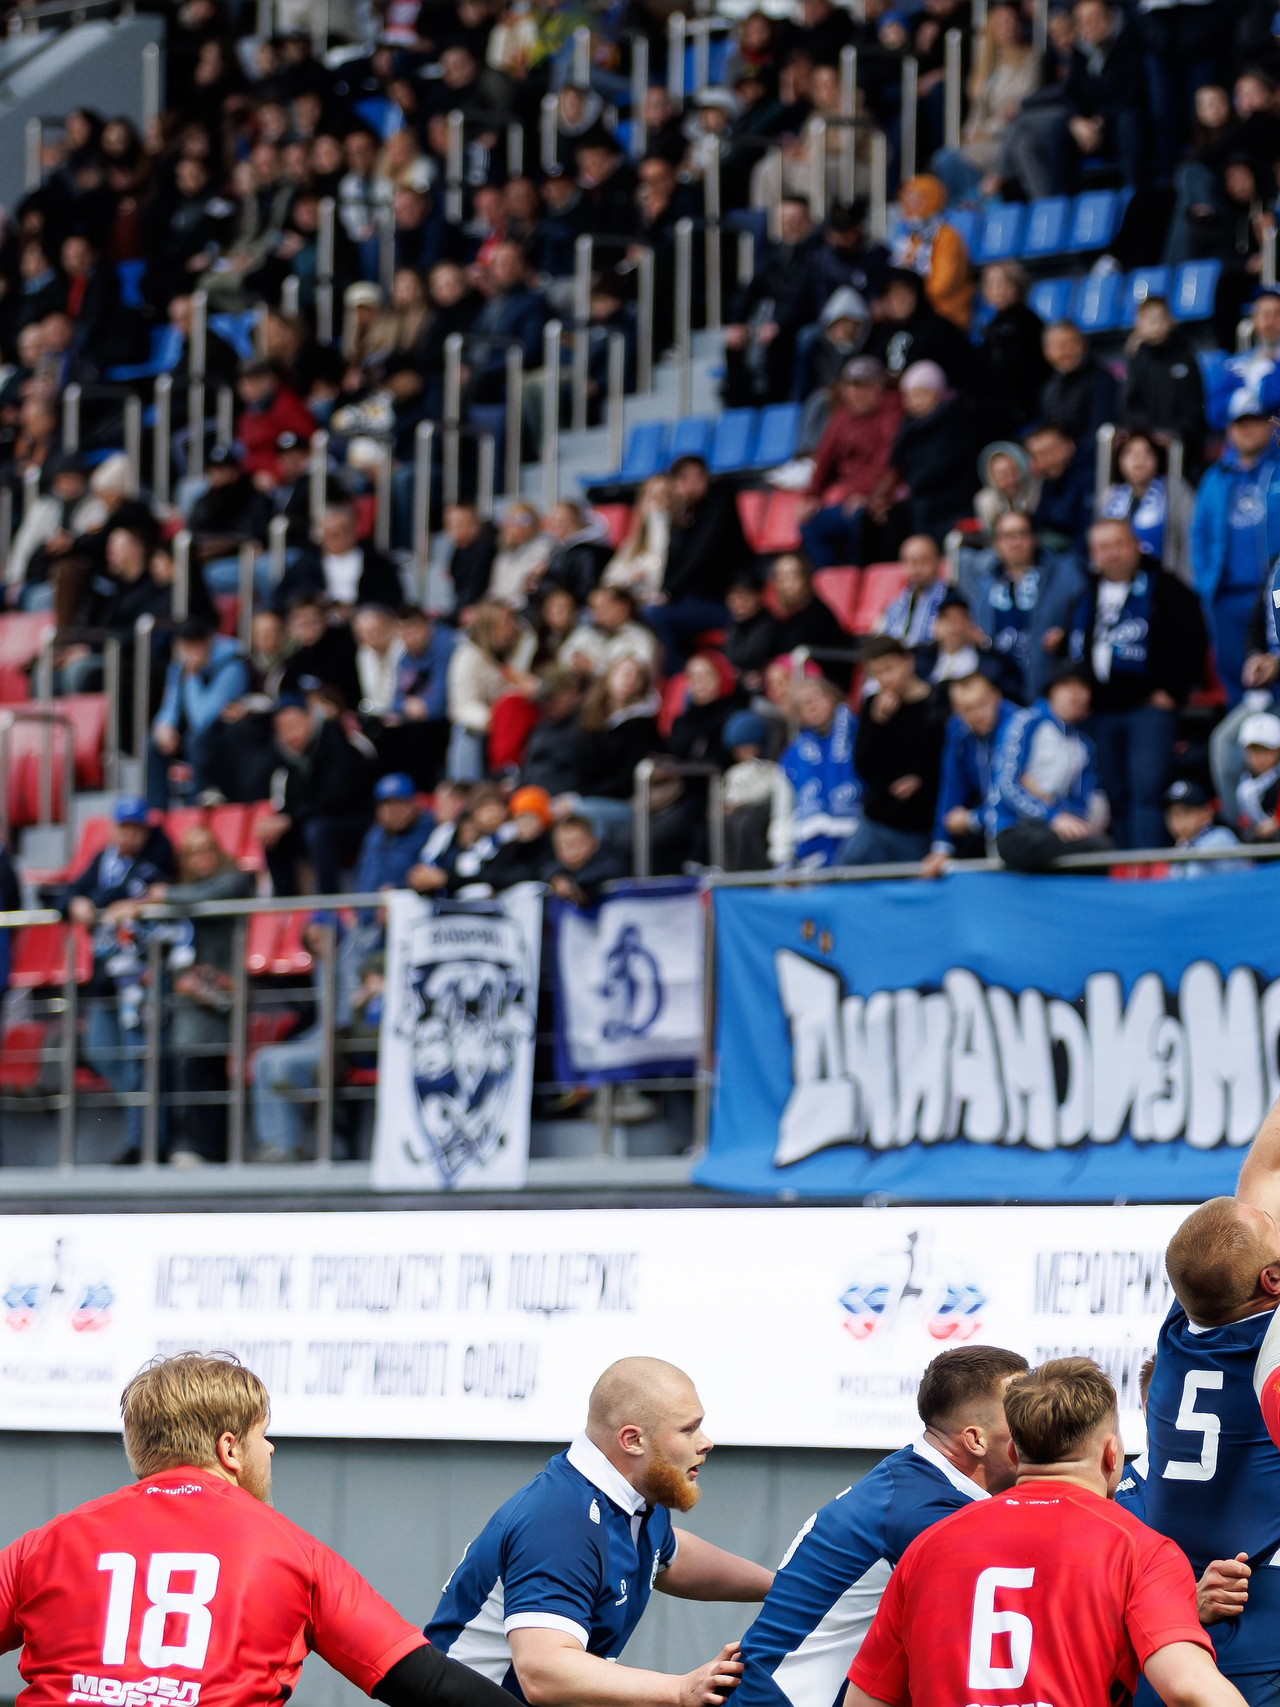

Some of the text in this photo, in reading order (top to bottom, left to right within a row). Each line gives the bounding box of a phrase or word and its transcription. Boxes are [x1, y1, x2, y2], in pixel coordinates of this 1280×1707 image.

[1162, 1369, 1224, 1482] 5
[97, 1552, 221, 1670] 18
[968, 1566, 1036, 1690] 6
